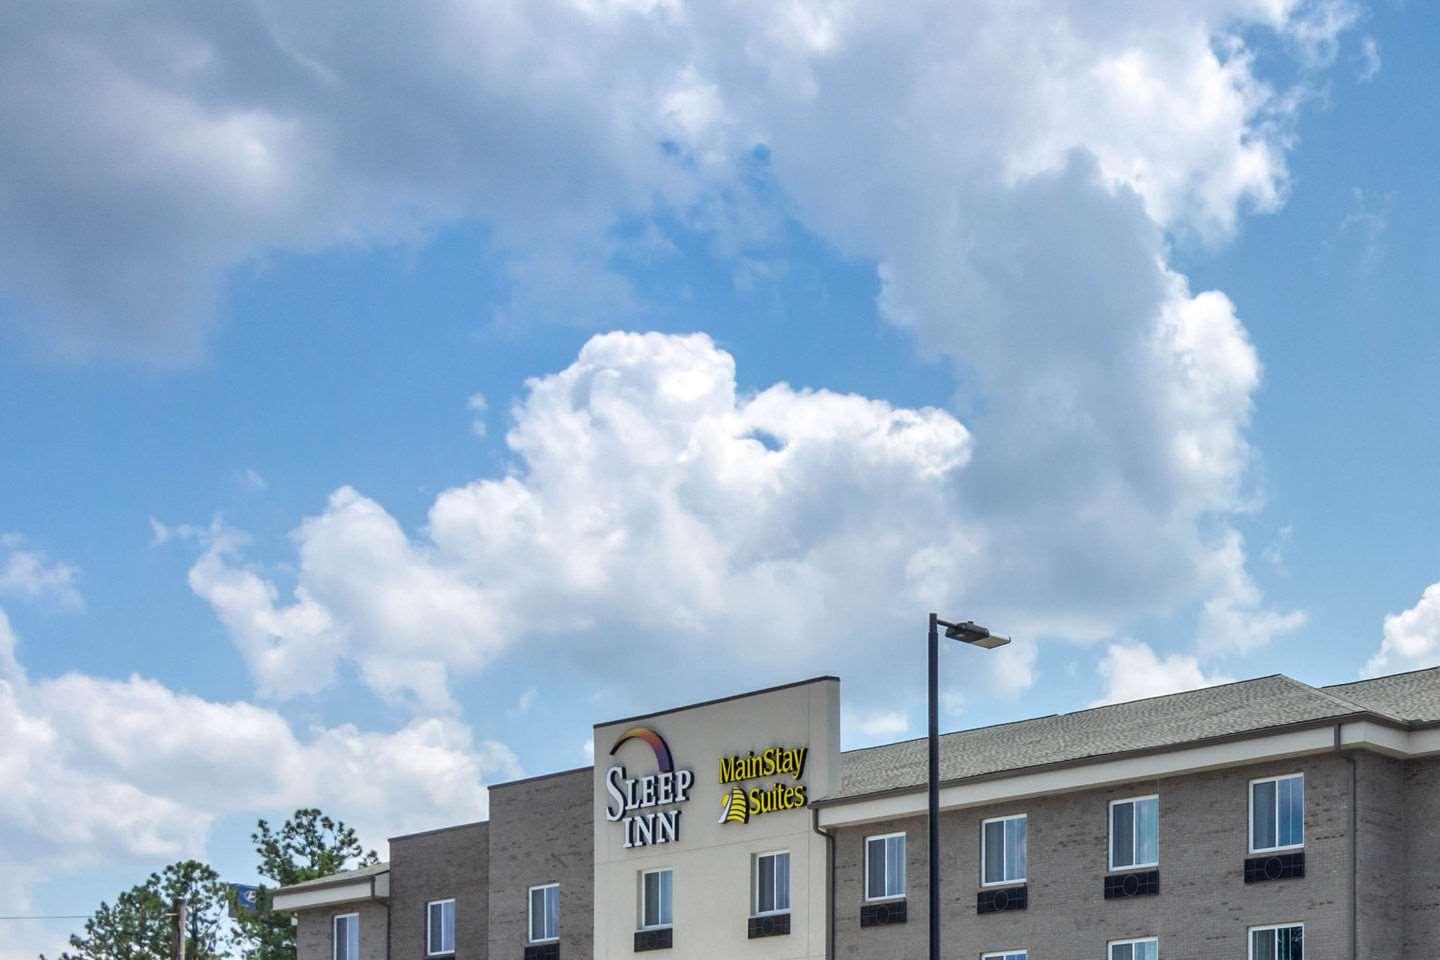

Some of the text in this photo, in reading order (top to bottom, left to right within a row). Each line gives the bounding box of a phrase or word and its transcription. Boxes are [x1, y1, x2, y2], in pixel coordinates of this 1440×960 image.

[719, 747, 806, 784] MainStay
[607, 766, 692, 821] SLEEP
[749, 784, 805, 814] Suites
[623, 811, 679, 847] INN
